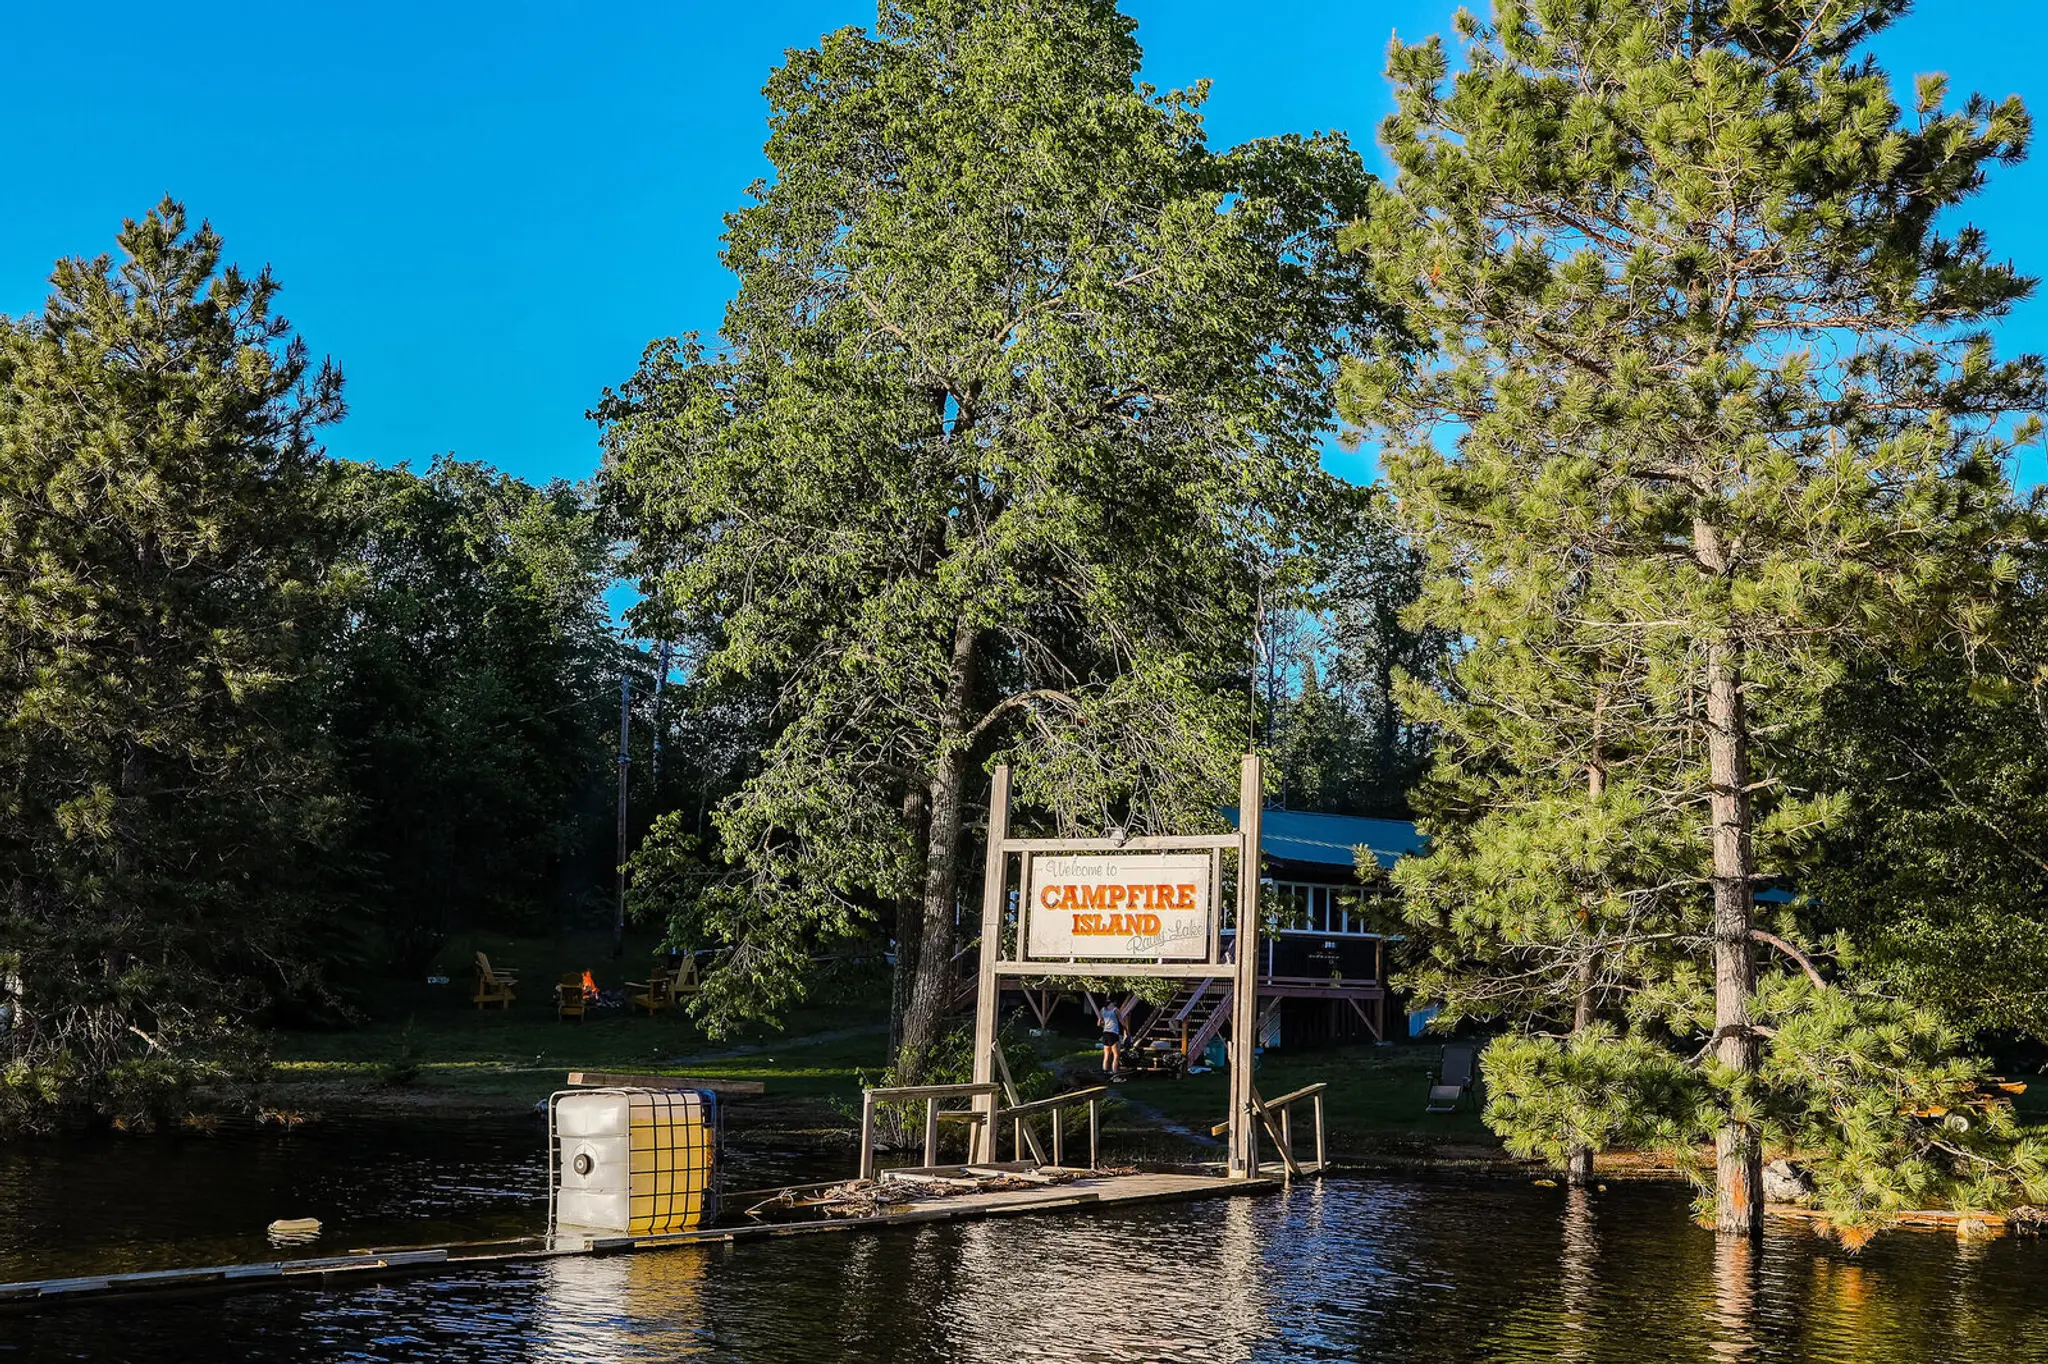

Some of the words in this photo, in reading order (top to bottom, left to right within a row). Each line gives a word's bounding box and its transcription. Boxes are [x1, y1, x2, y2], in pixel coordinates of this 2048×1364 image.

[1046, 859, 1102, 877] Welcome
[1106, 862, 1118, 877] to
[1040, 884, 1197, 910] CAMPFIRE
[1071, 913, 1162, 936] ISLAND
[1168, 919, 1205, 940] Lake
